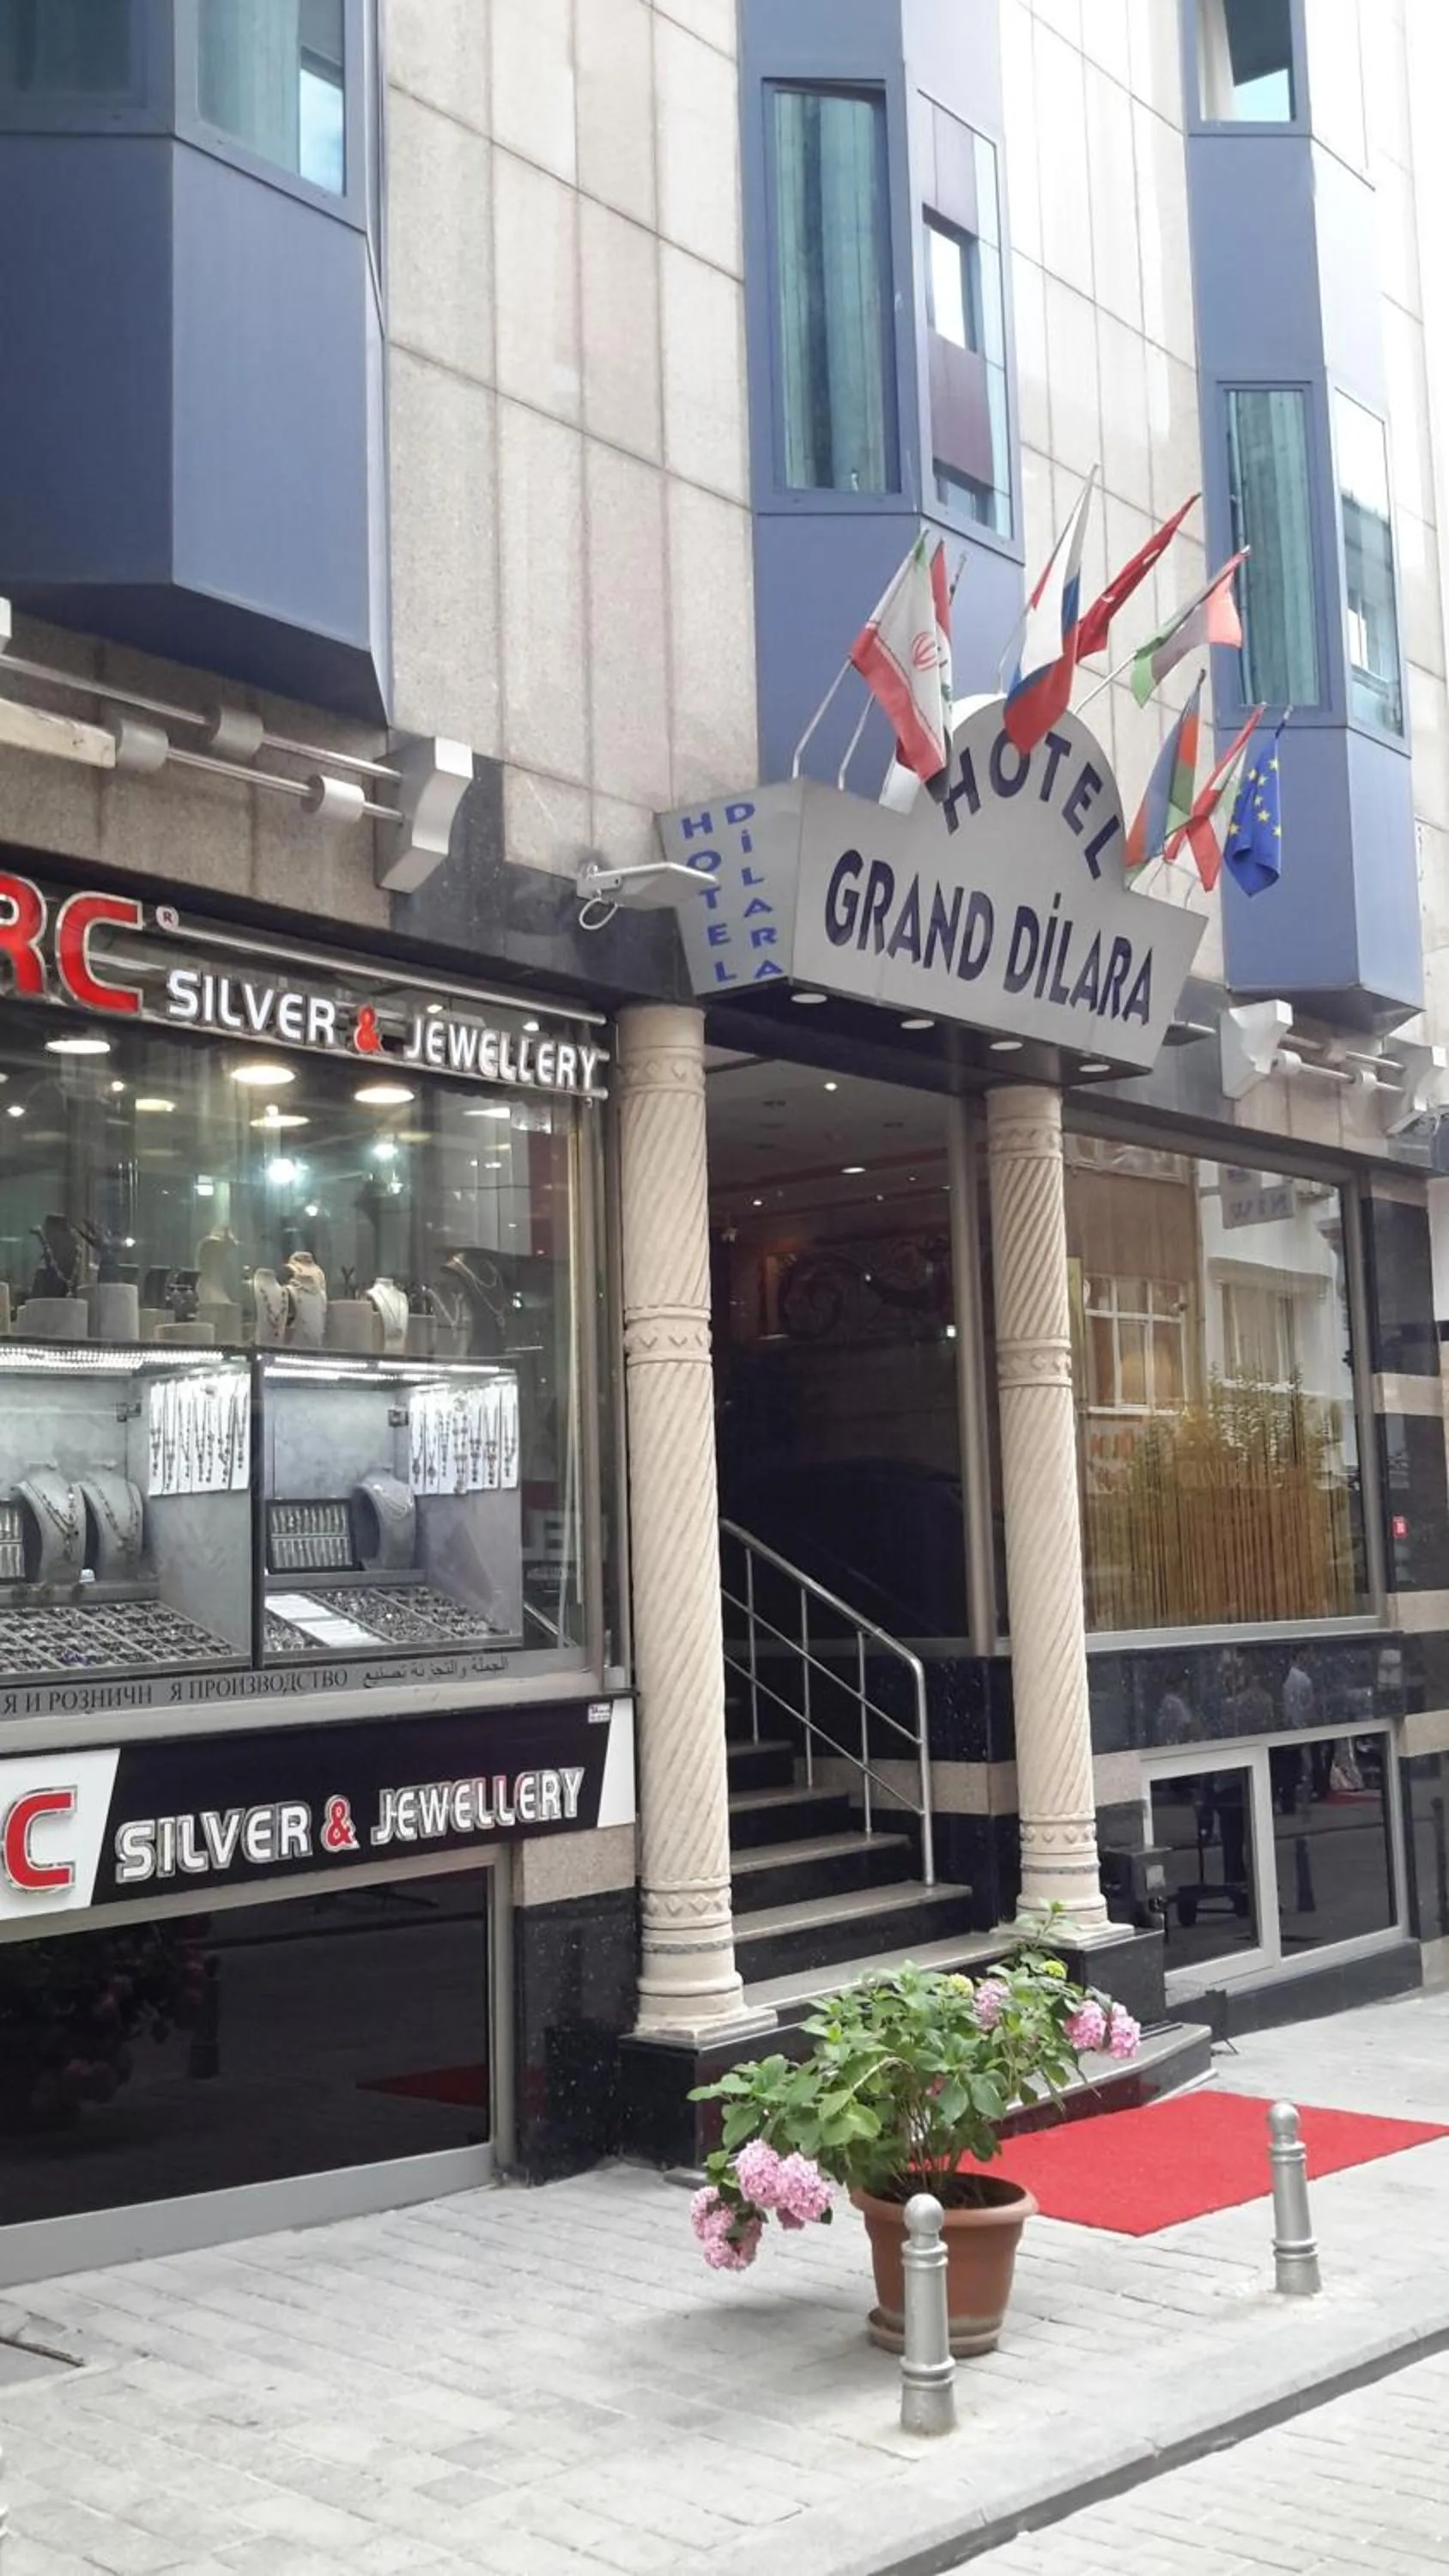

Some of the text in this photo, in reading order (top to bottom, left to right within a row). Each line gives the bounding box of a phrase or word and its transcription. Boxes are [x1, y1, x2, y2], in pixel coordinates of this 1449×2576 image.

[943, 727, 1121, 880] HOTEL
[682, 811, 738, 983] HOTEL
[824, 849, 995, 981] GRAND
[167, 969, 598, 1091] SILVER & JEWELLERY
[114, 1767, 585, 1885] SILVER & JEWELLERY
